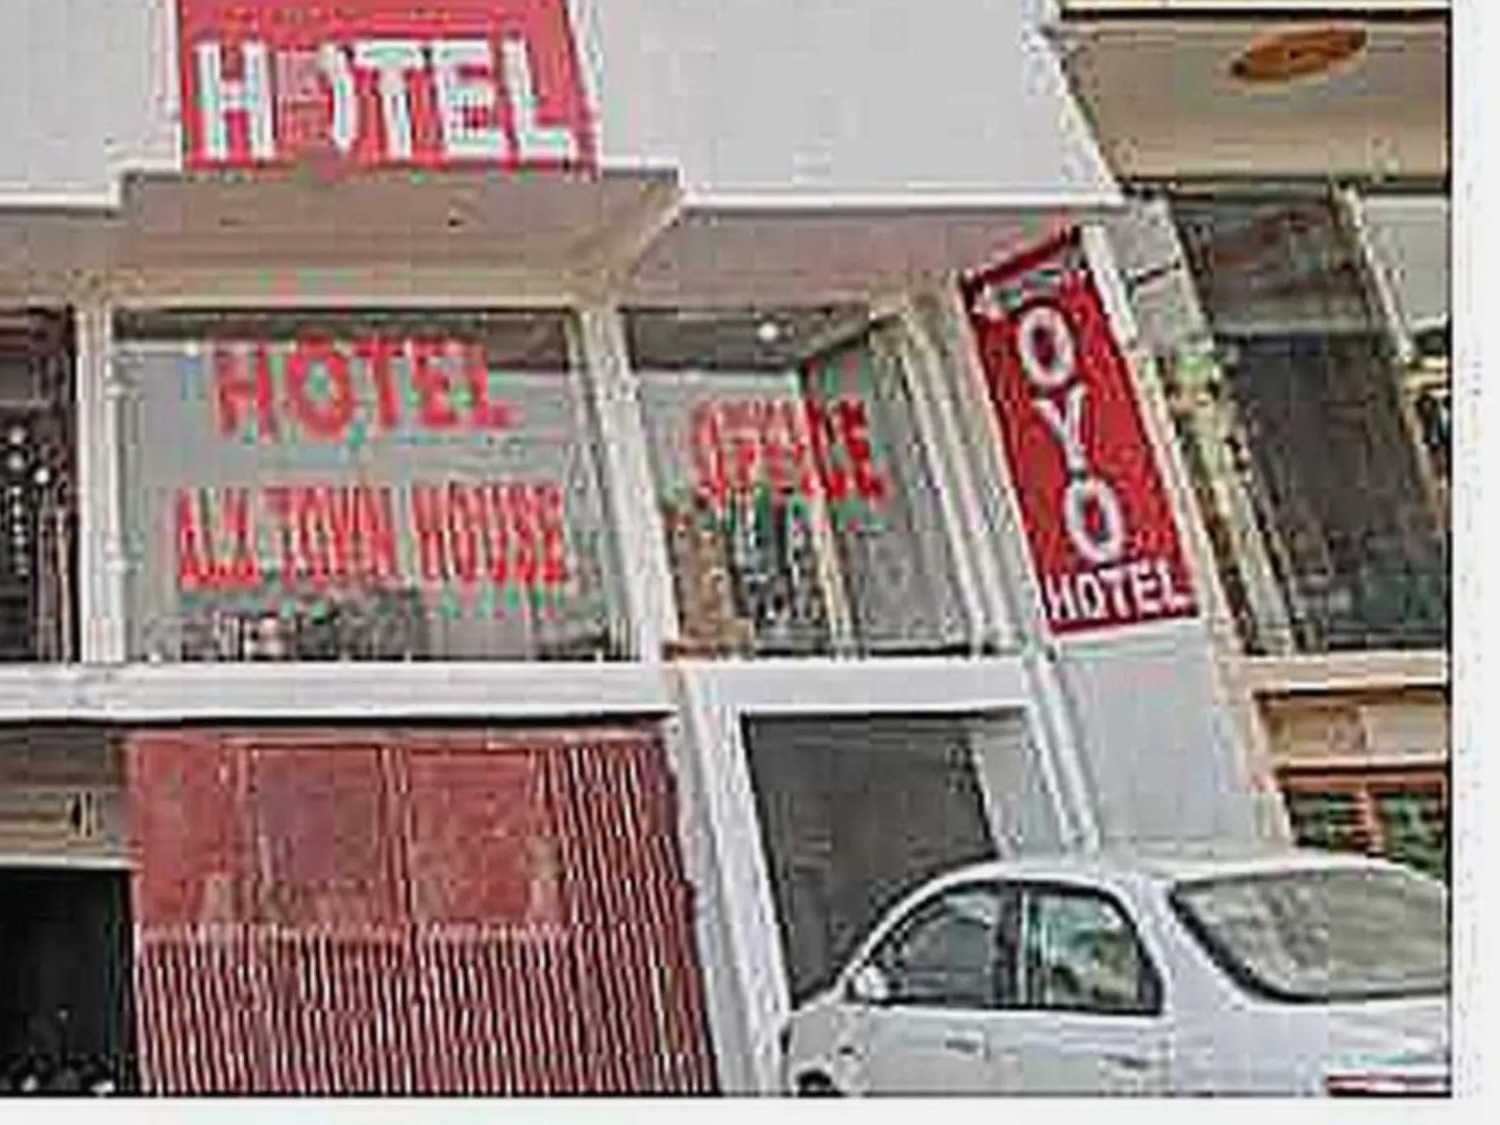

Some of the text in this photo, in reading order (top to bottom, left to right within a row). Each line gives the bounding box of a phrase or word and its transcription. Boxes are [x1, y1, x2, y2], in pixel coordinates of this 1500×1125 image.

[212, 335, 522, 443] HOTEL
[1017, 305, 1124, 563] OYO
[1046, 559, 1194, 622] HOTEL
